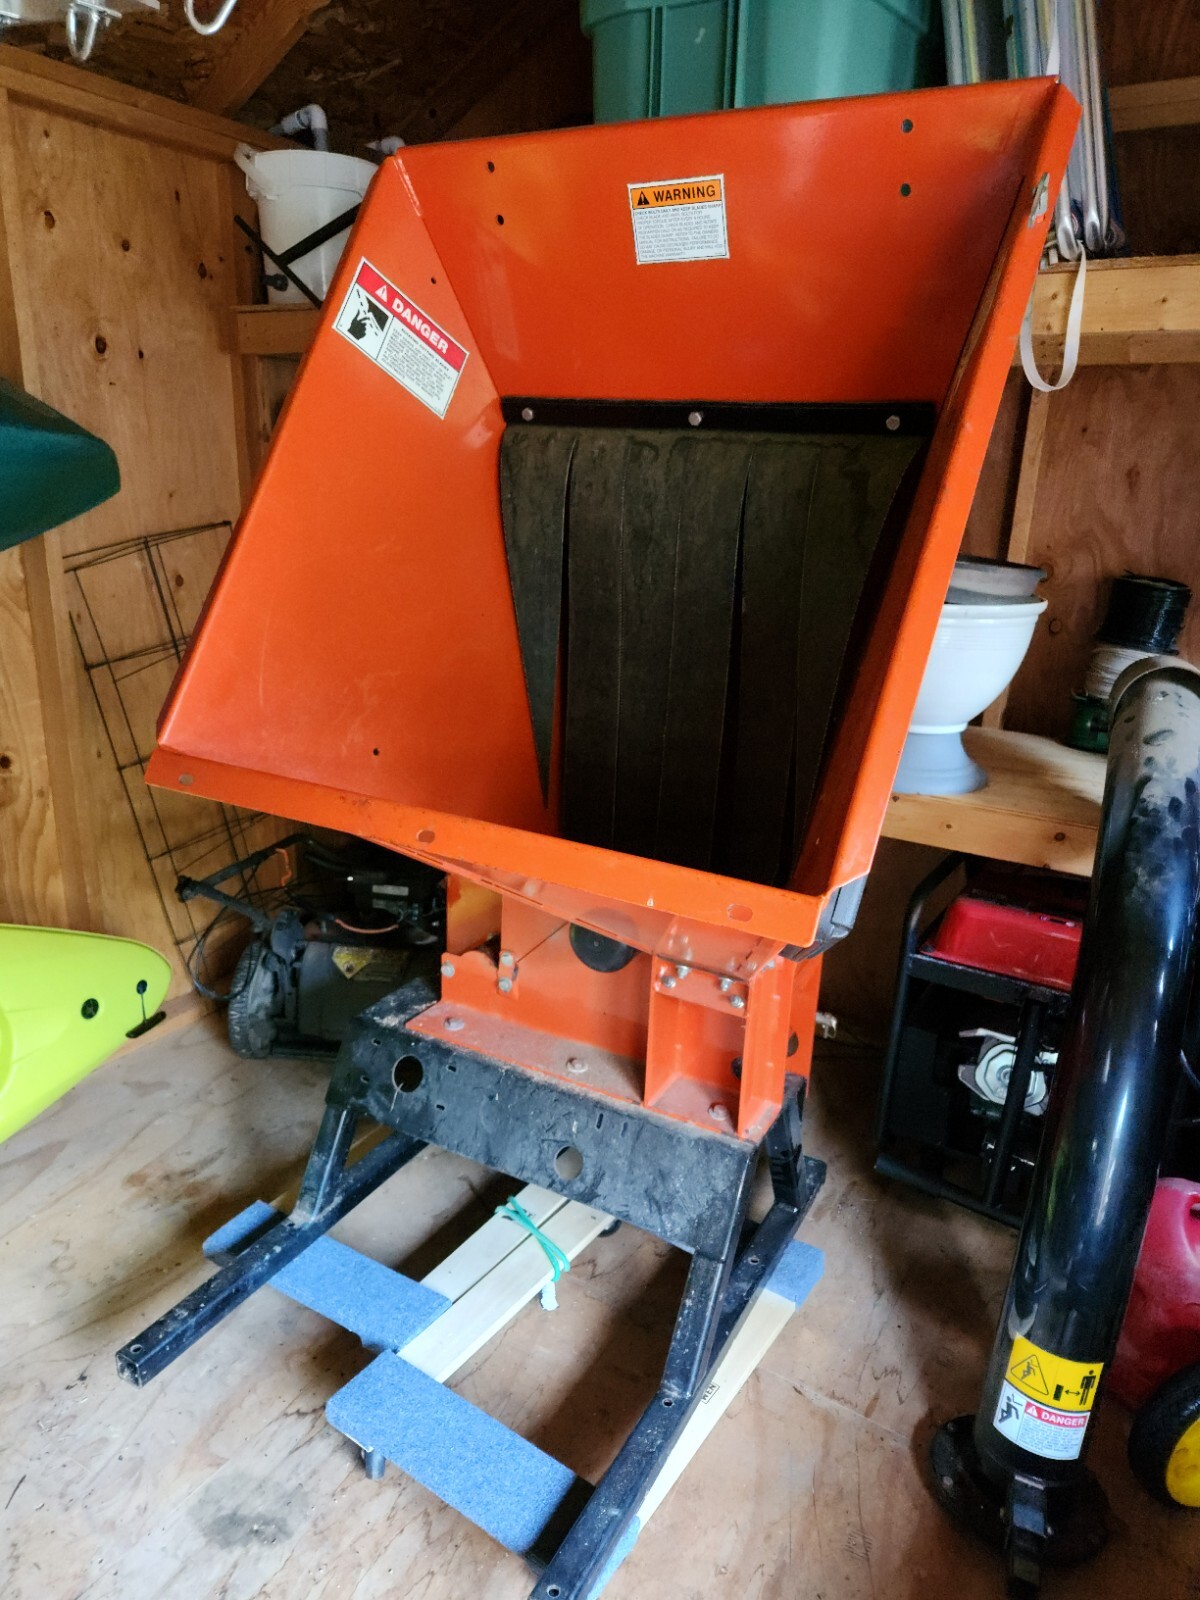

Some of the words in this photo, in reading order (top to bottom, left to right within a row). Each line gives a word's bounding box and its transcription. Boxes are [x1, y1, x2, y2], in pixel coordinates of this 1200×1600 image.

[653, 185, 716, 202] WARNING
[392, 298, 448, 354] DANGER
[1041, 1411, 1085, 1426] DANGER
